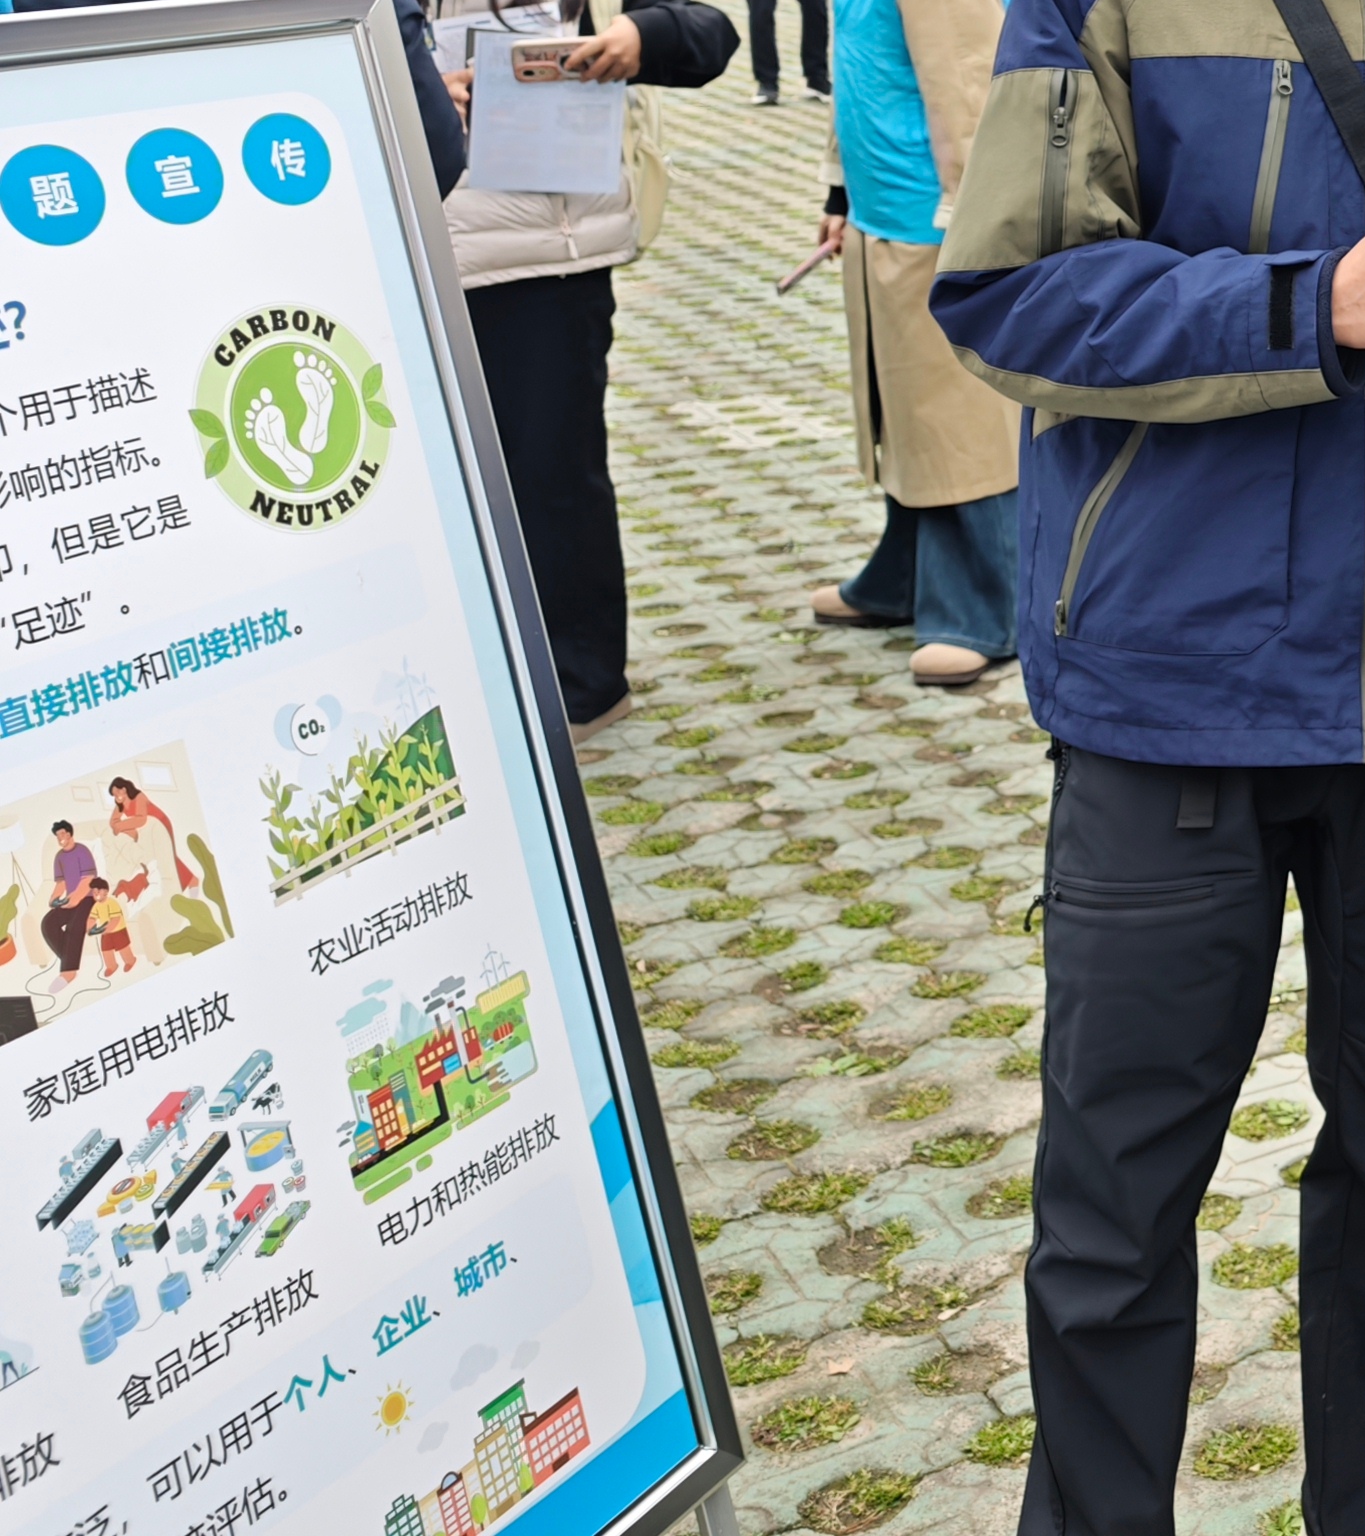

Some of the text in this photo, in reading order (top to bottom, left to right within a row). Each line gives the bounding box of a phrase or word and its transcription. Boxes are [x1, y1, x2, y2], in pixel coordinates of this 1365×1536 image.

[213, 309, 337, 367] CARBON
[248, 459, 381, 527] NEUTRAL
[308, 870, 473, 976] 农业活动排放
[22, 990, 236, 1123] 家庭用电排放
[376, 1112, 561, 1247] 电力和热能排放
[117, 1268, 320, 1420] 食品生产排放
[184, 1477, 288, 1536] 评估。
